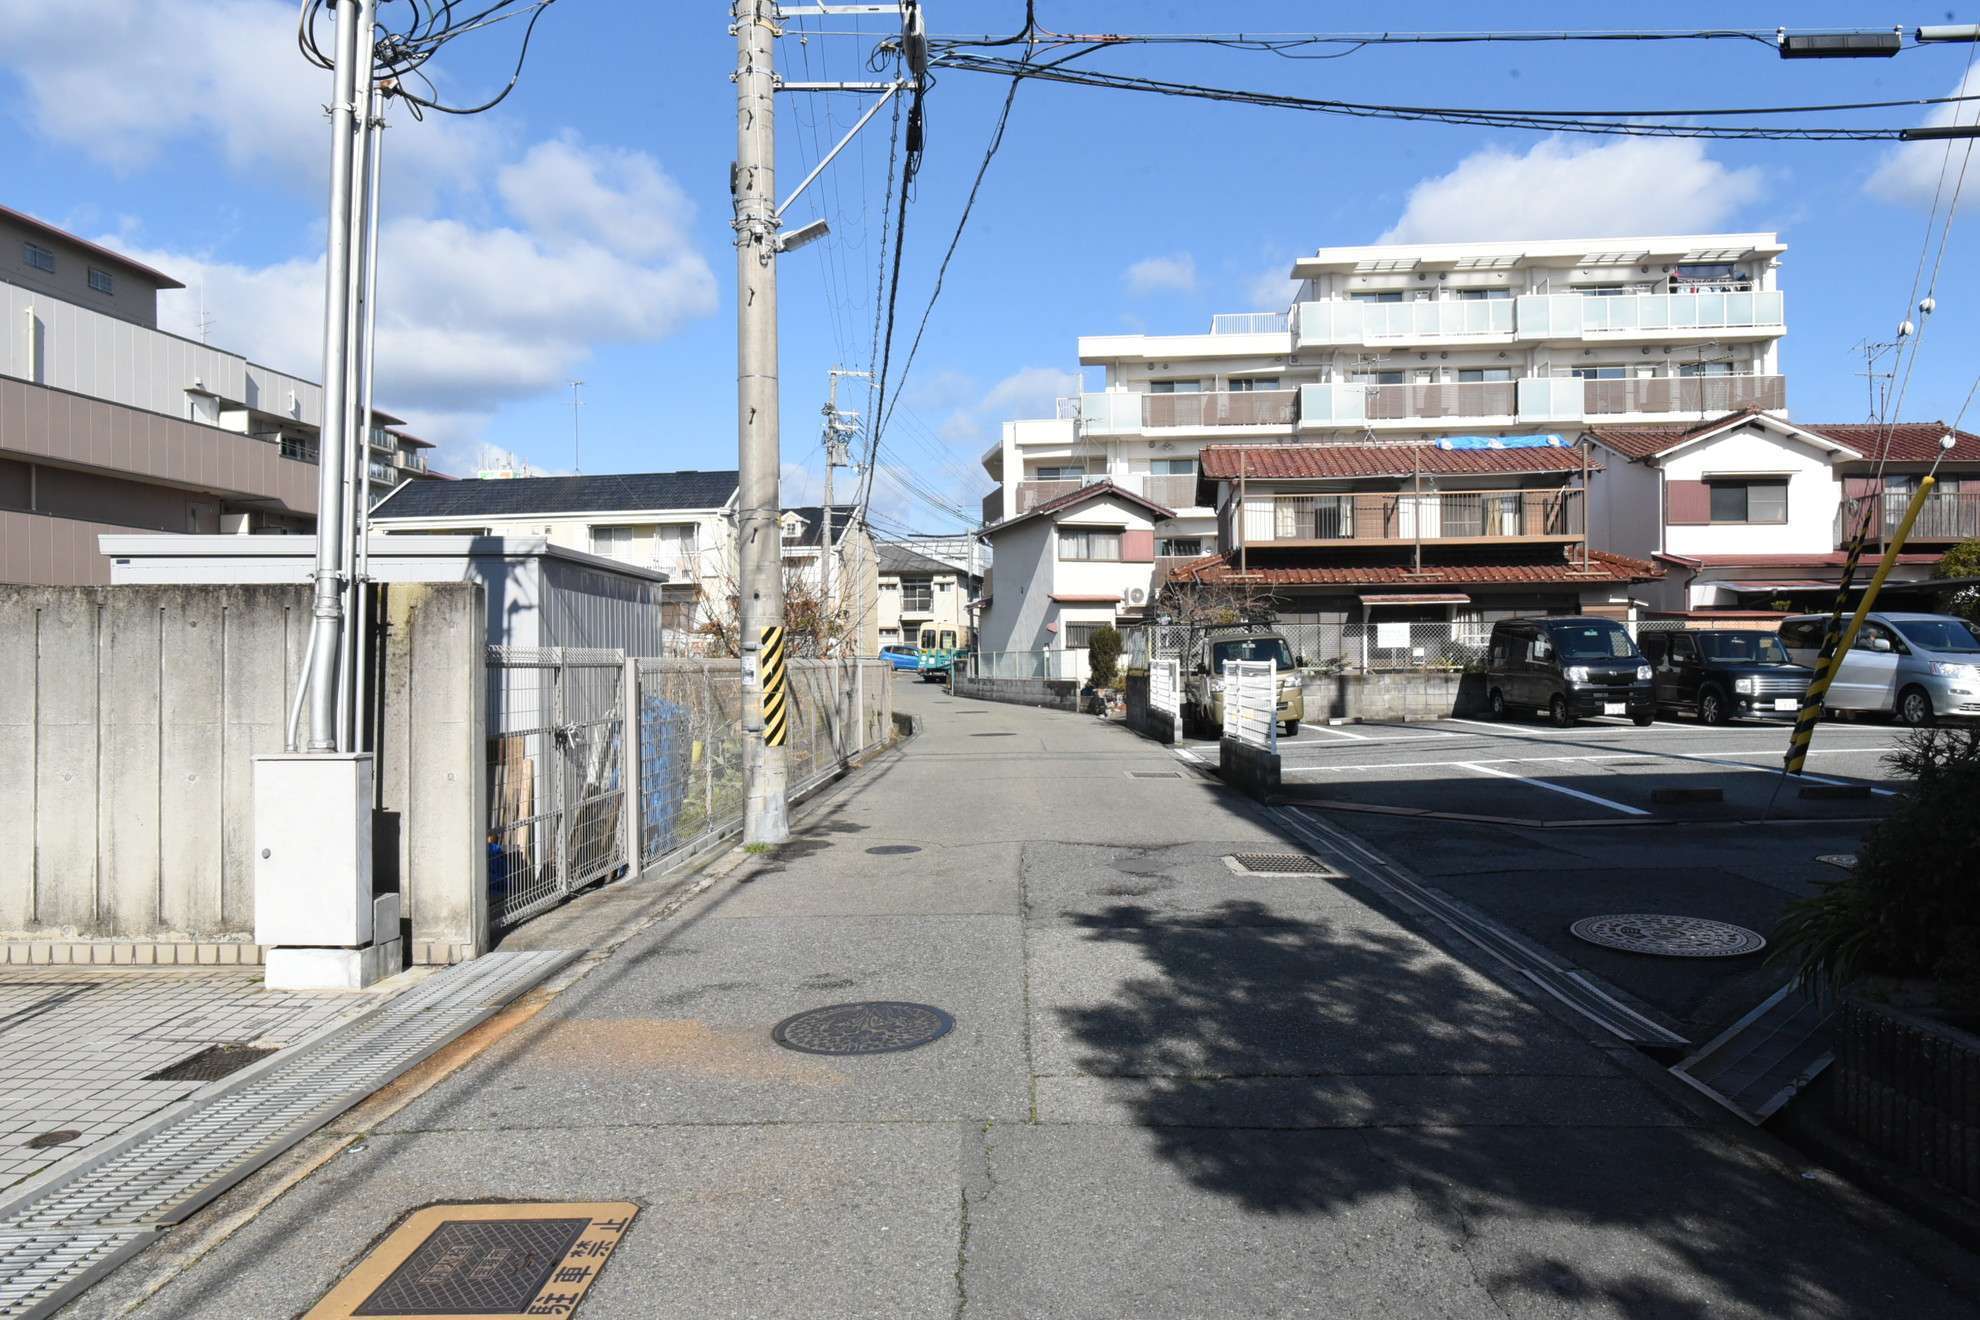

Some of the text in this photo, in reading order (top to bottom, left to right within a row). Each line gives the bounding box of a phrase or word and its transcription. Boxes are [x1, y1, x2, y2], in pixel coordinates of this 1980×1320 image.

[419, 1246, 472, 1285] 消火栓
[527, 1217, 628, 1315] 駐車禁止
